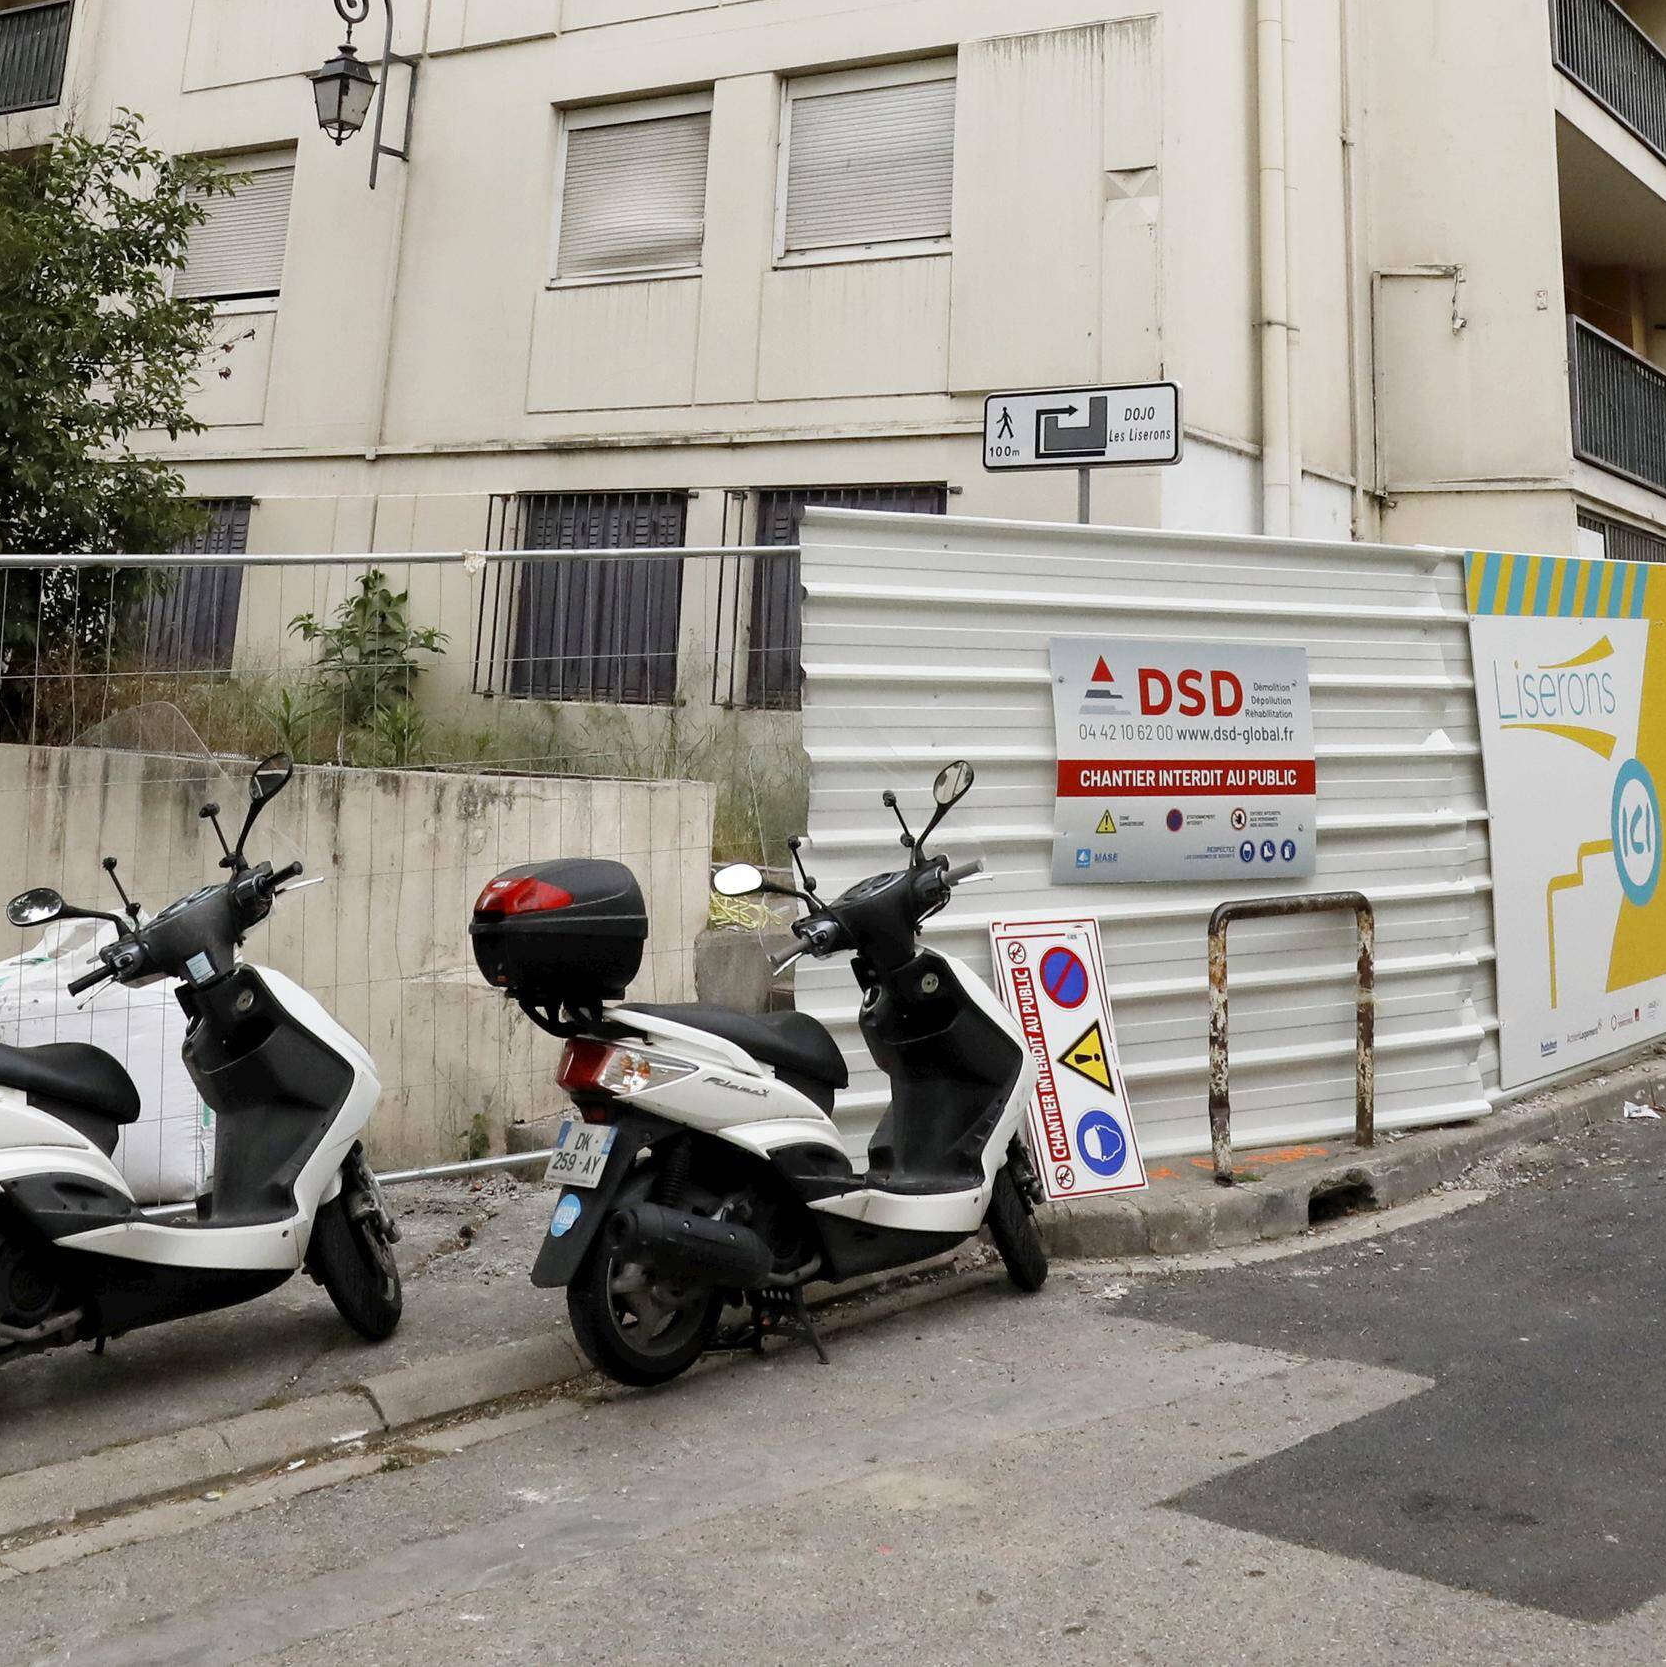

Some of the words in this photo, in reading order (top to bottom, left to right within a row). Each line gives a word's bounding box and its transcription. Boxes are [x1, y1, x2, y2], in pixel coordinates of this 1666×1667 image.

[1124, 406, 1155, 421] DOJO
[1109, 429, 1125, 443] Les
[1129, 427, 1171, 442] Liserons
[1138, 667, 1244, 717] DSD
[1253, 681, 1290, 692] Démolition
[1493, 660, 1615, 719] Liserons
[1251, 695, 1291, 707] Dépollution
[1245, 708, 1293, 719] Réhabilitation
[1079, 724, 1096, 741] 04
[1100, 724, 1117, 740] 42
[1121, 724, 1133, 740] 10
[1137, 724, 1152, 740] 62
[1157, 724, 1173, 740] 00
[1177, 725, 1294, 745] www.dsd-global.fr
[1080, 769, 1155, 787] CHANTIER
[1159, 769, 1223, 787] INTERDIT
[1226, 770, 1245, 786] AU
[1248, 769, 1297, 786] PUBLIC
[1623, 802, 1651, 857] ICI
[1014, 969, 1038, 1016] PUBLIC
[1024, 1017, 1042, 1033] AU
[1029, 1036, 1054, 1093] INTERDIT
[1041, 1094, 1068, 1159] CHANTIER
